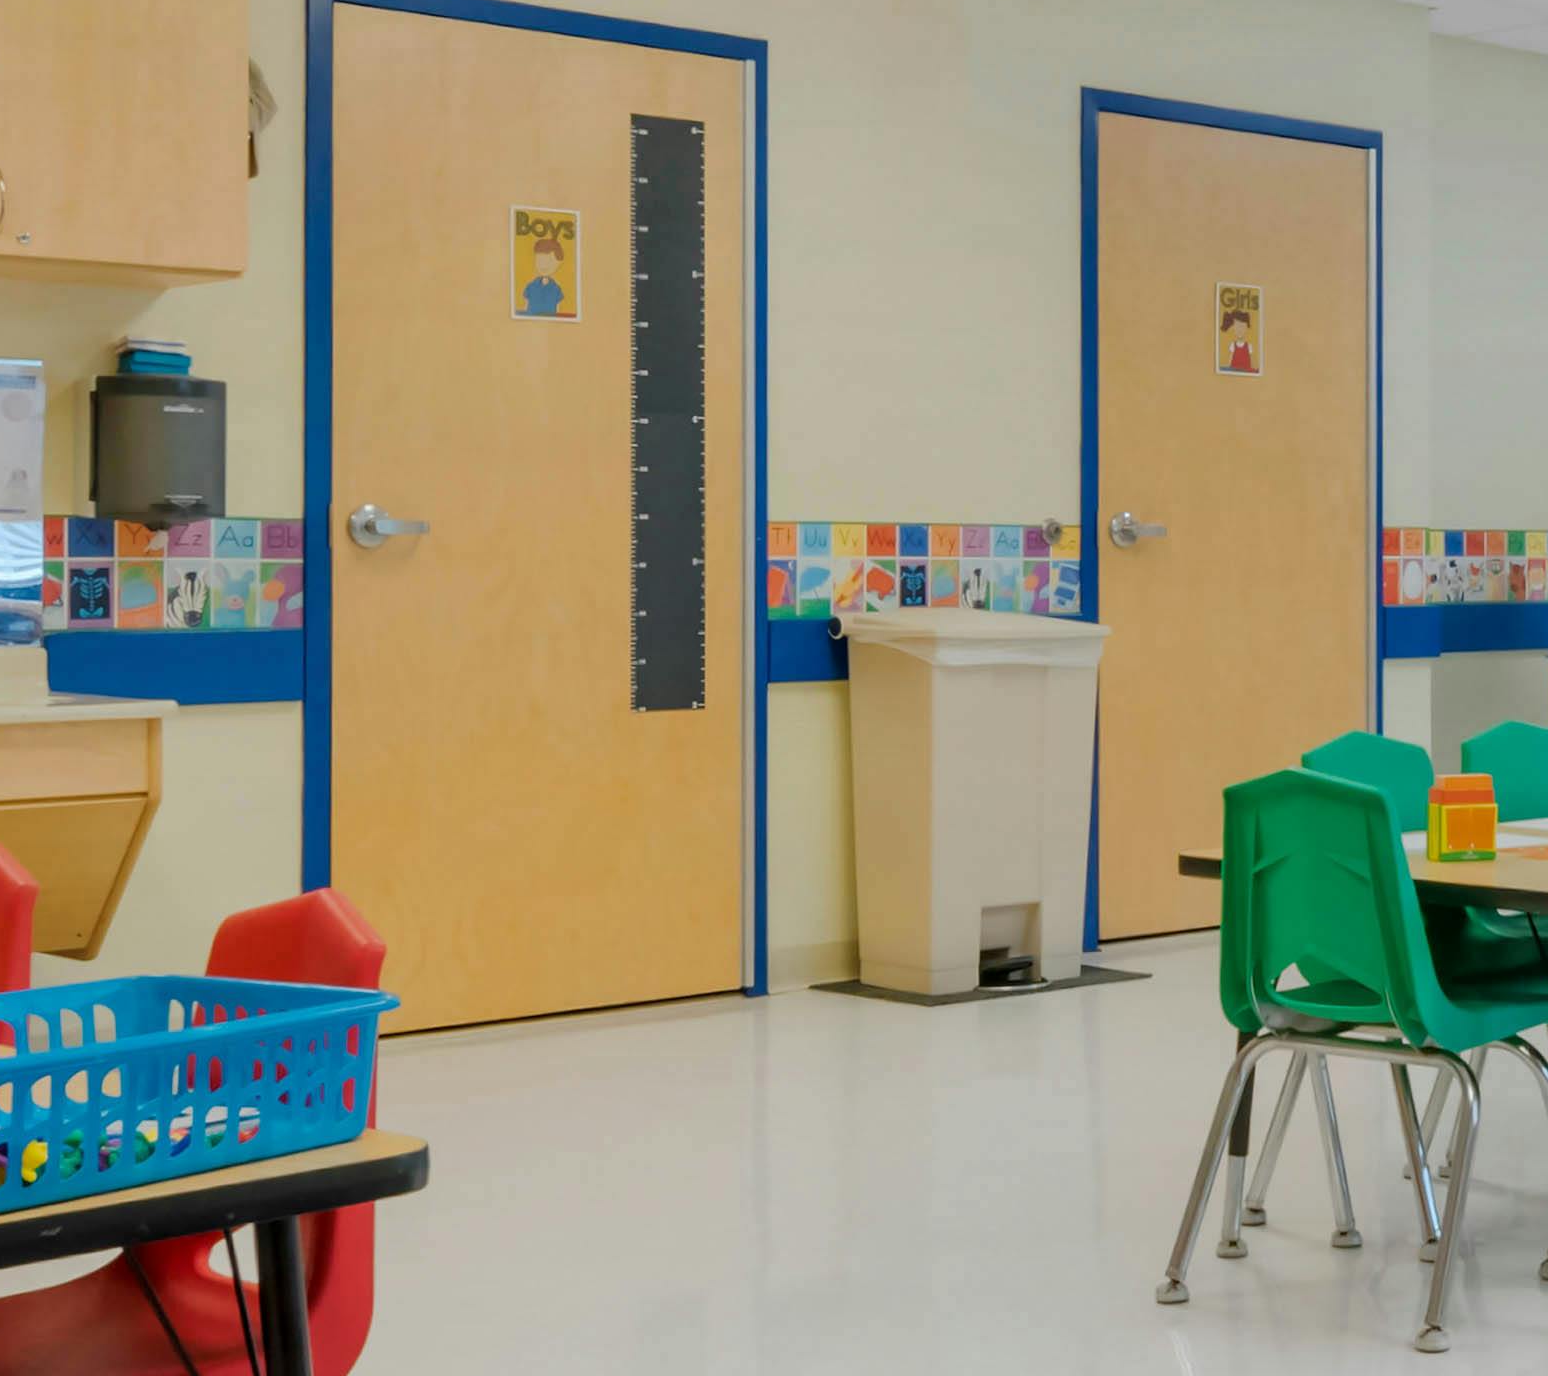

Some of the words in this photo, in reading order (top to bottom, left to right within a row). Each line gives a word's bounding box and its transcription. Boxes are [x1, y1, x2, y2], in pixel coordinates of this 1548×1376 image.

[515, 210, 575, 241] Boys
[1220, 288, 1259, 310] Girls
[174, 524, 203, 546] Zz
[217, 525, 254, 548] Aa
[267, 525, 300, 548] Bb
[804, 529, 827, 549] Uu
[838, 529, 860, 549] Vv
[868, 530, 896, 549] Ww
[936, 529, 956, 555] Yy
[996, 530, 1020, 551] Aa
